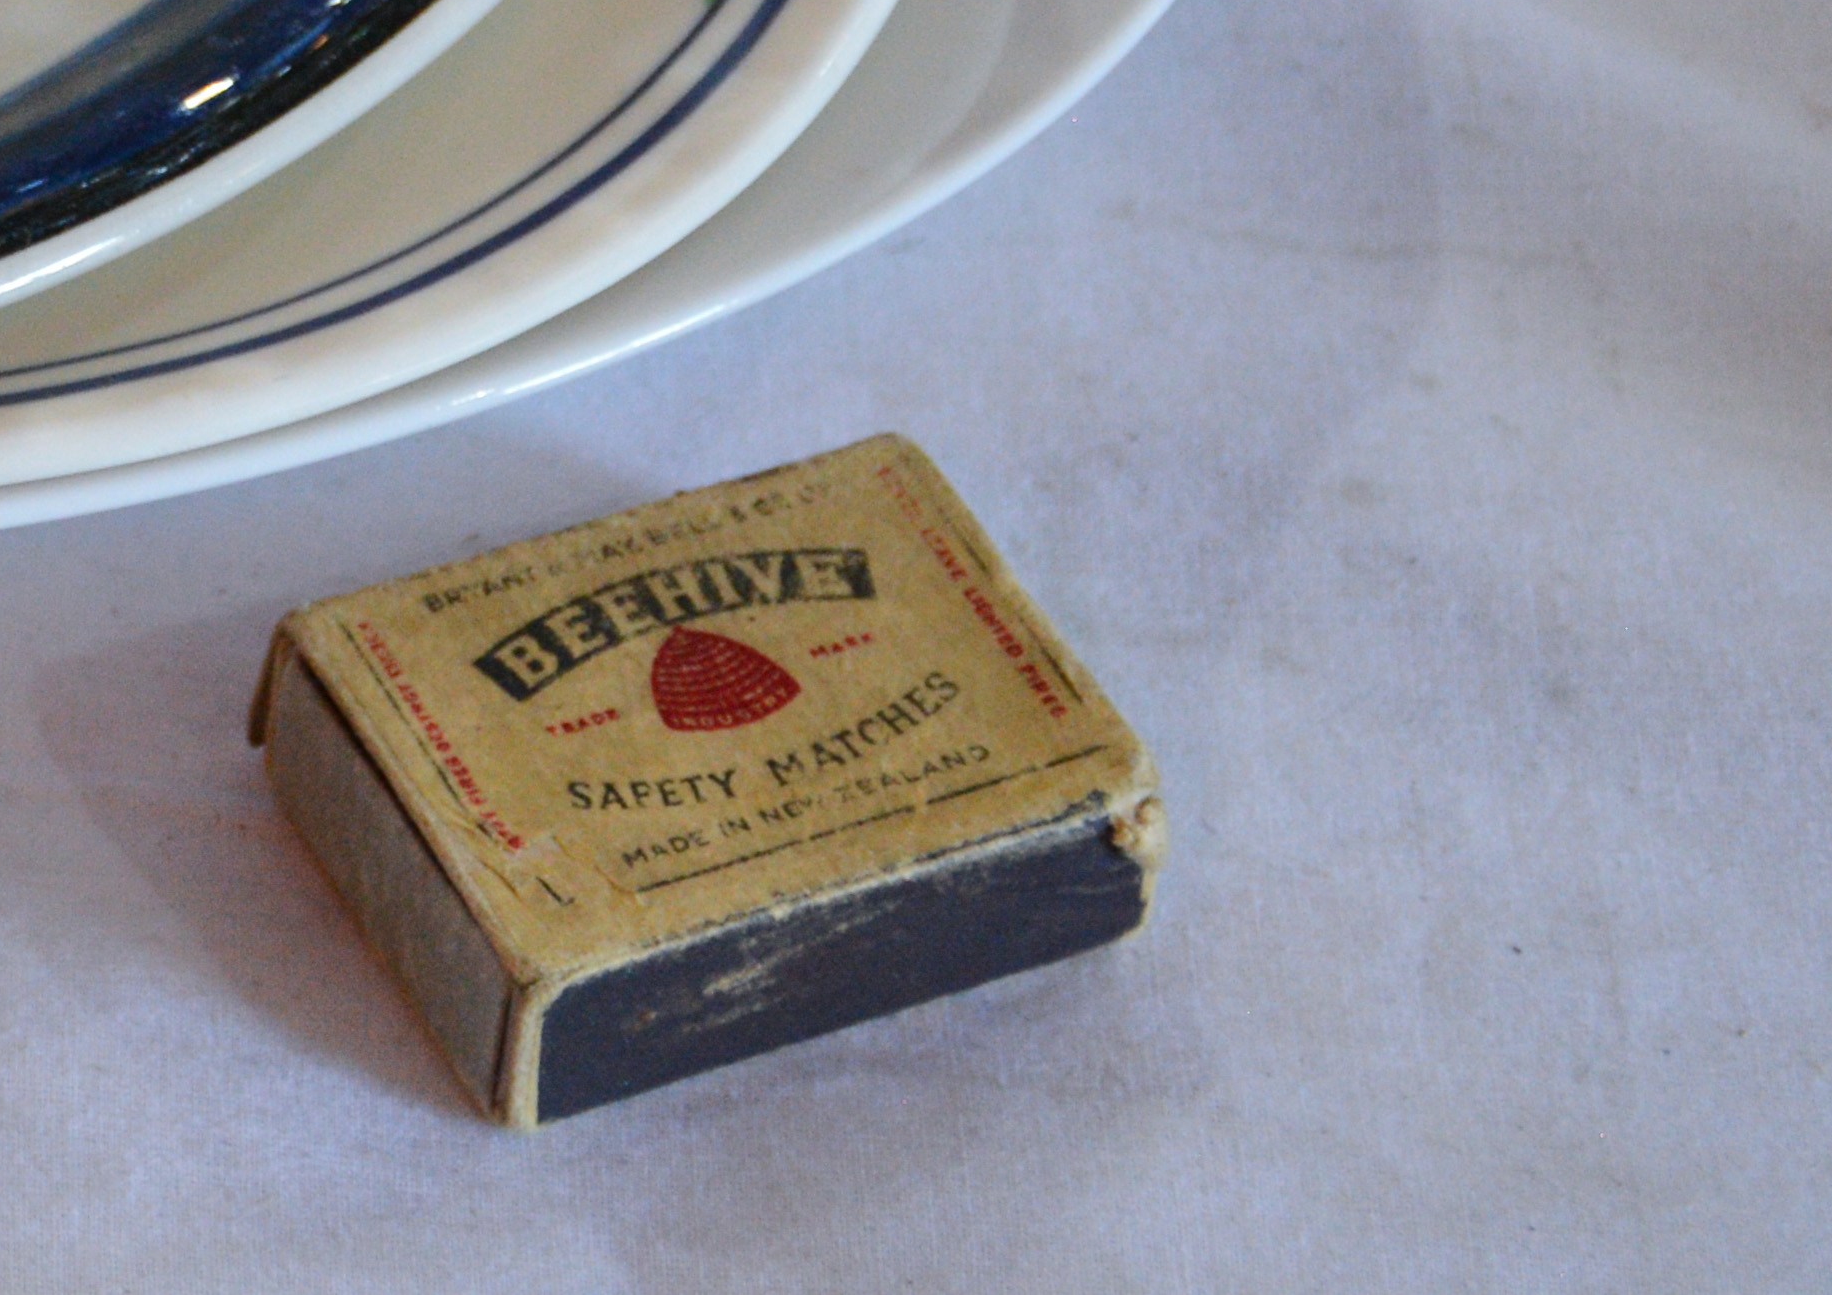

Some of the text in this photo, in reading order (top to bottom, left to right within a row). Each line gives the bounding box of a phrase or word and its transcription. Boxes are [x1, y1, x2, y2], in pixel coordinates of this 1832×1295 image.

[493, 552, 857, 690] BEEHIVE
[544, 631, 875, 737] TRADE MARK
[566, 670, 962, 812] SAFETY MATCHES
[620, 830, 710, 869] MADE
[720, 815, 751, 839] IN
